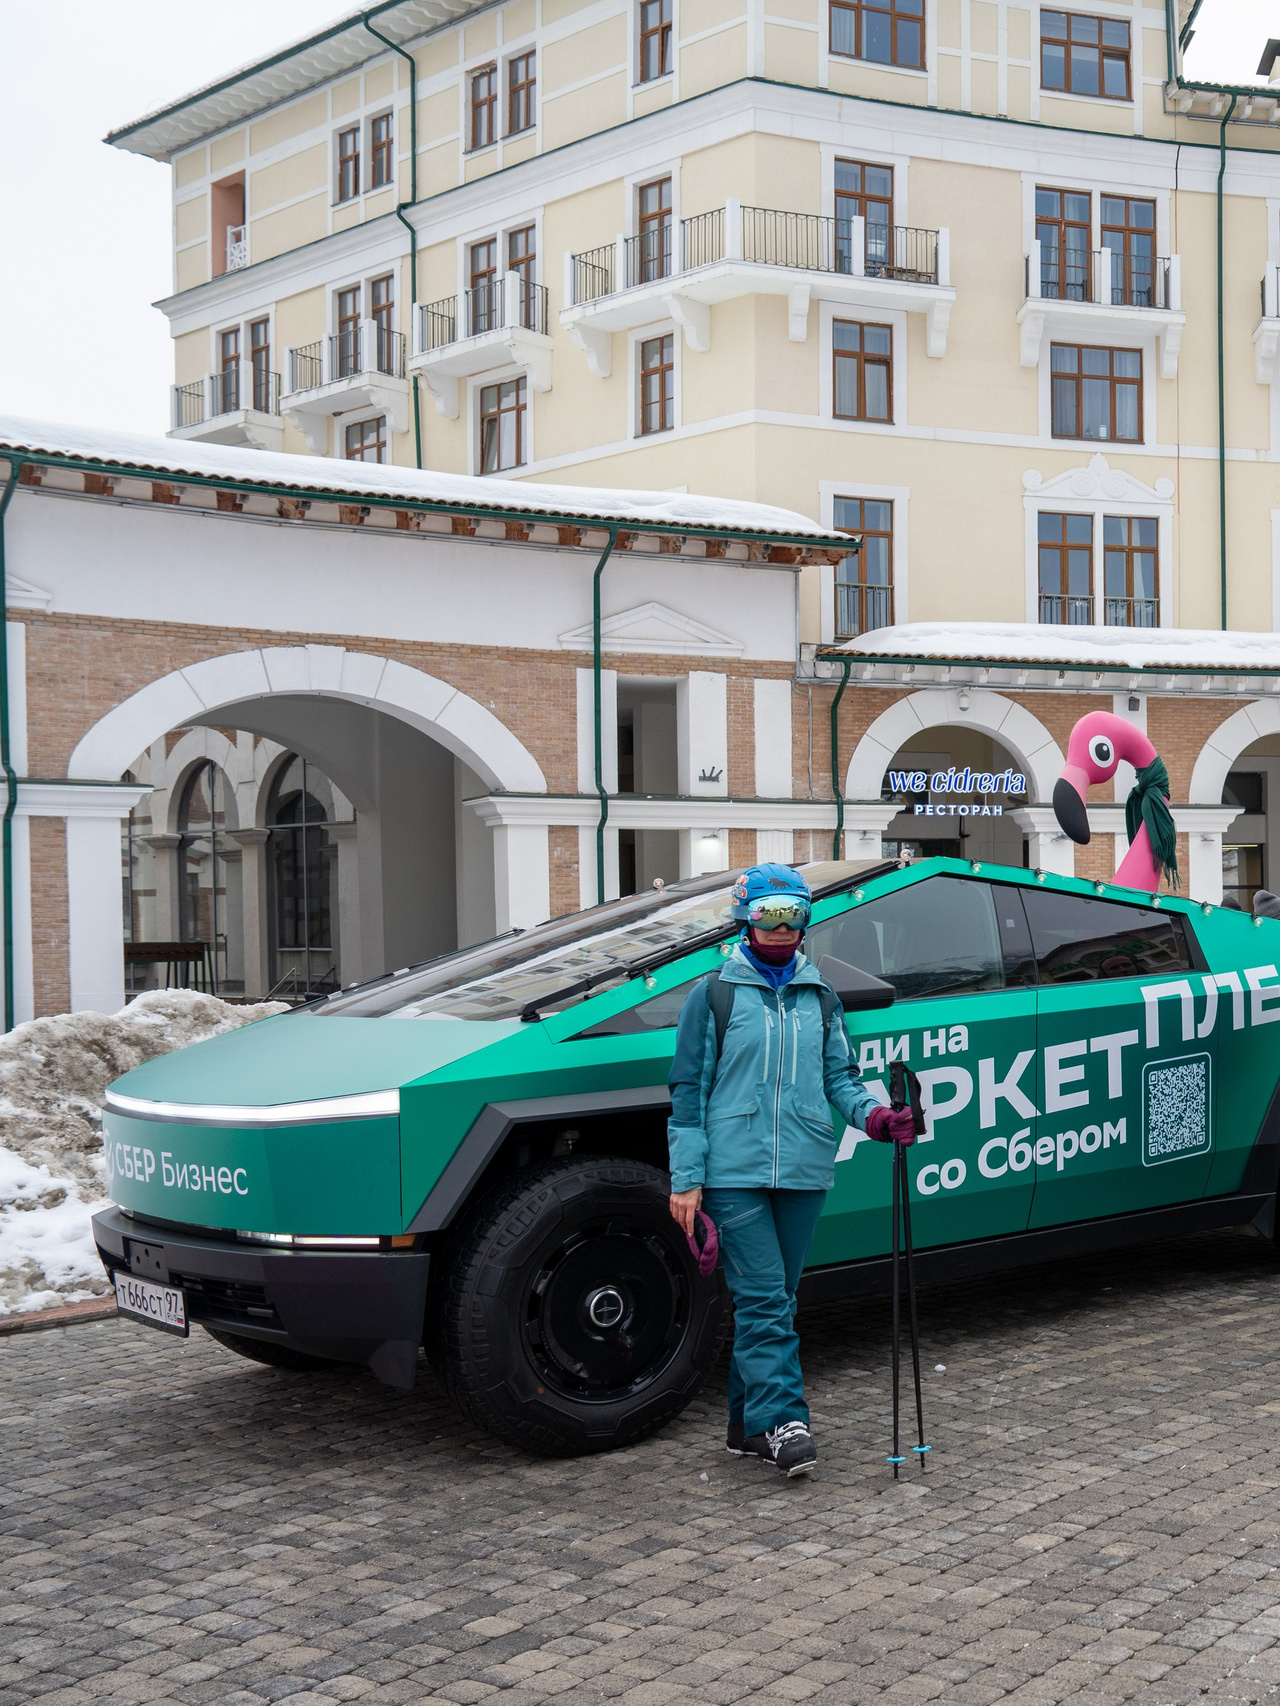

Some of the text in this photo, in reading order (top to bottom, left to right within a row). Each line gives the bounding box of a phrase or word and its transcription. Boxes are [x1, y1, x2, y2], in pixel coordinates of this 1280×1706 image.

[889, 766, 1027, 794] we cidreria
[914, 804, 1003, 817] РЕСТОРАН
[852, 1025, 969, 1077] ди на
[115, 1142, 249, 1196] СБЕР Бизнес
[916, 1117, 1127, 1196] со Сбером
